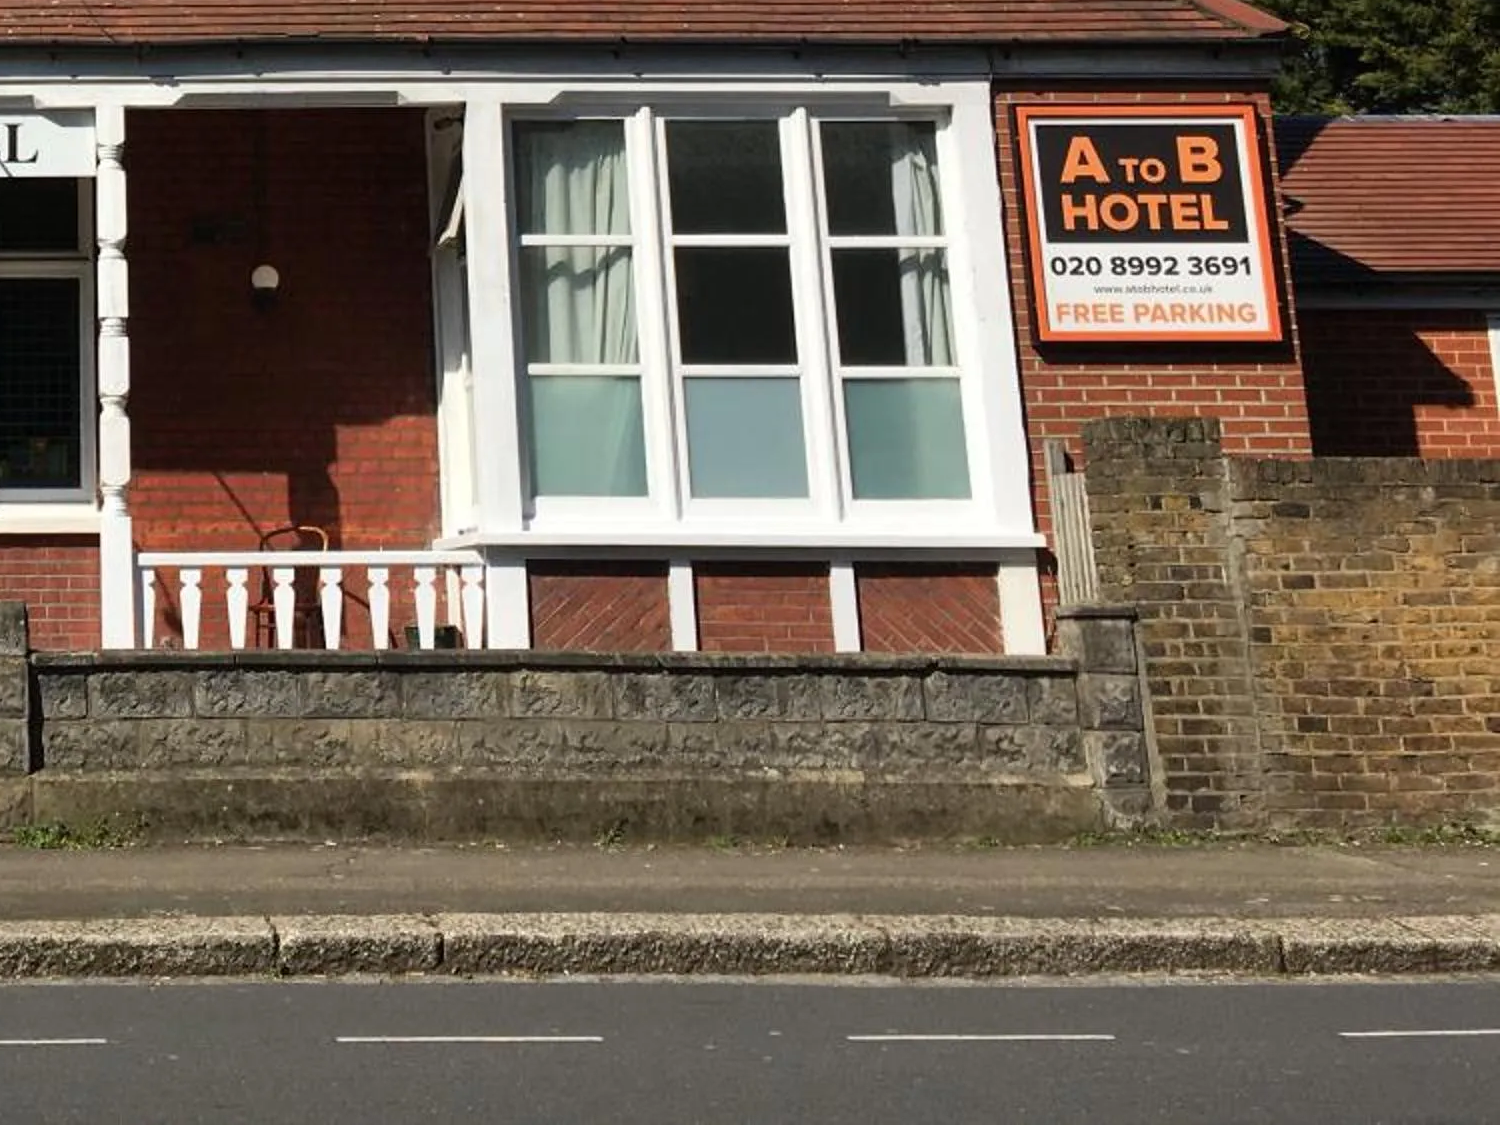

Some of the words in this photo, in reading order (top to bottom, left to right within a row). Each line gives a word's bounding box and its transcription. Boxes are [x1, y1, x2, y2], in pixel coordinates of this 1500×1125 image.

[1060, 136, 1111, 183] A
[1118, 158, 1167, 183] TO
[1176, 136, 1223, 183] B
[1060, 193, 1230, 231] HOTEL
[1050, 256, 1103, 276] 020
[1110, 256, 1181, 276] 8992
[1187, 256, 1252, 276] 3691
[1055, 302, 1126, 324] FREE
[1133, 302, 1258, 324] PARKING
